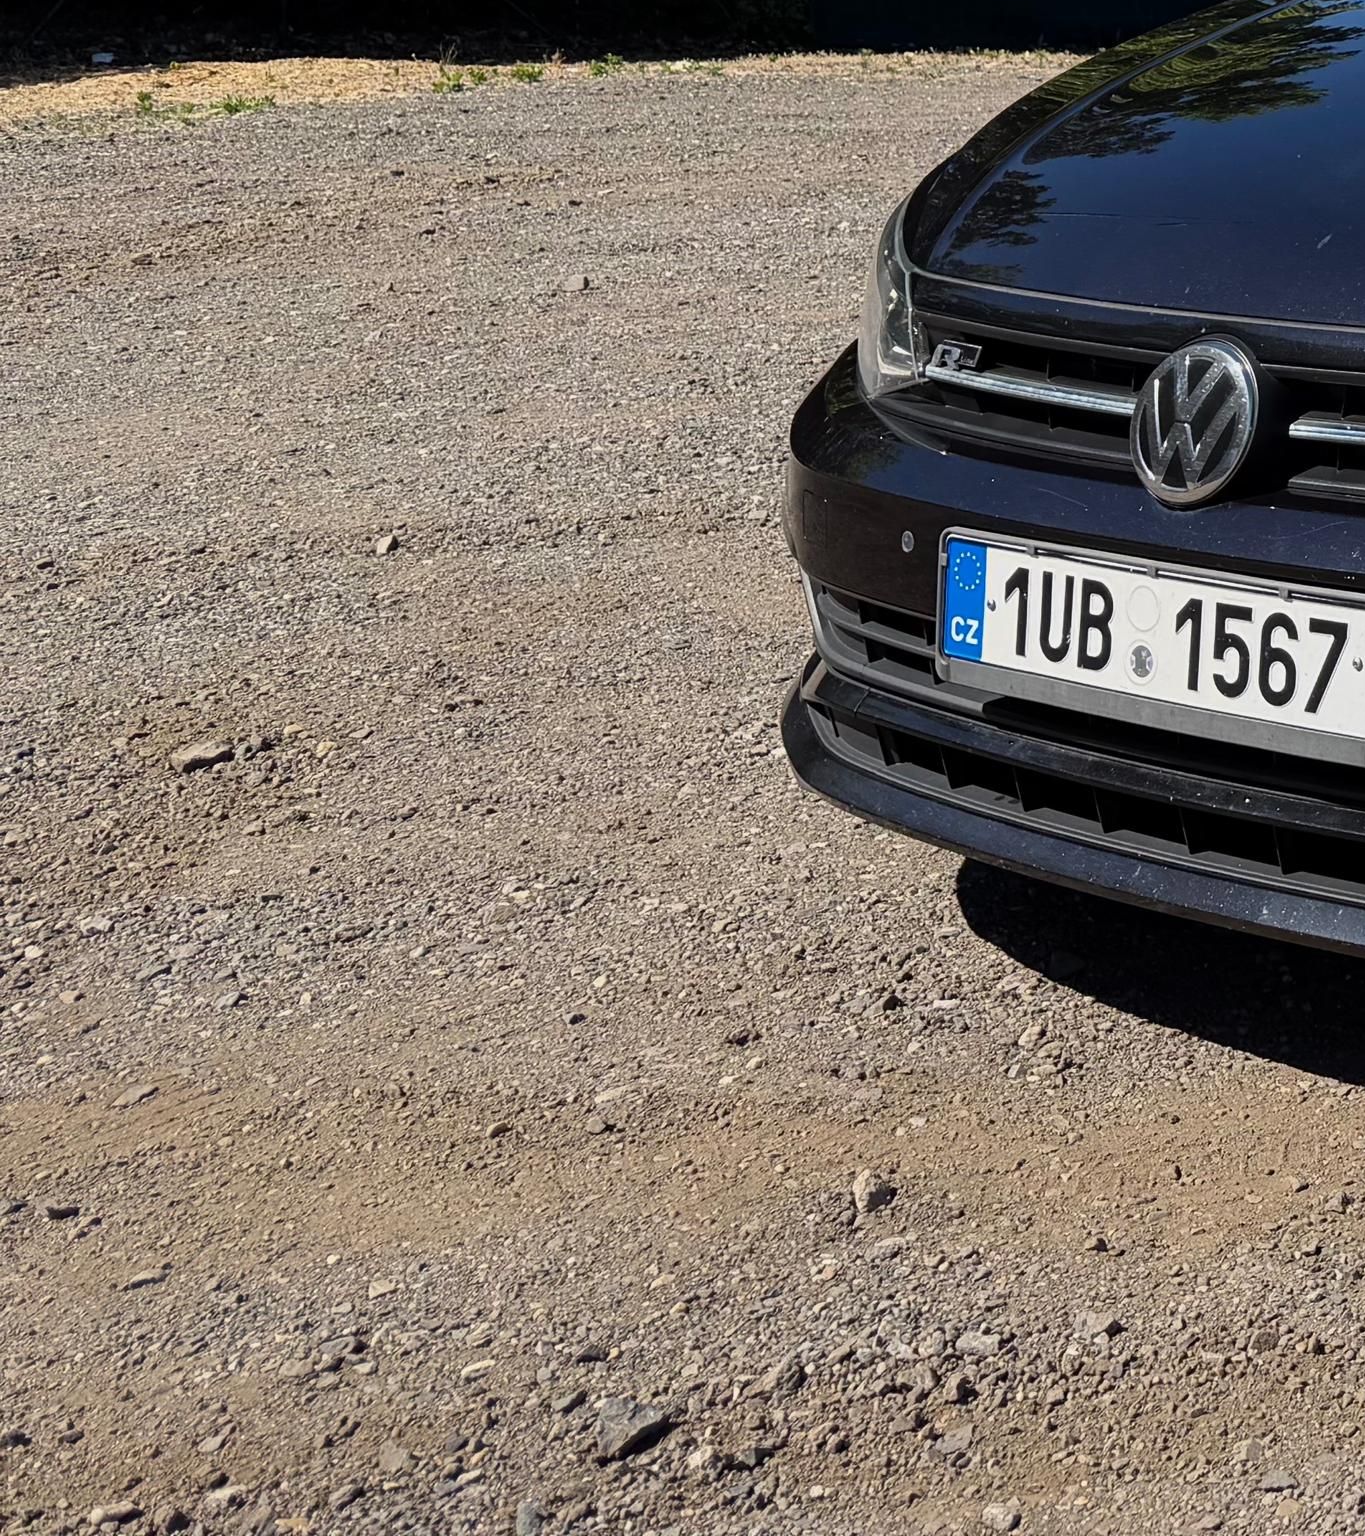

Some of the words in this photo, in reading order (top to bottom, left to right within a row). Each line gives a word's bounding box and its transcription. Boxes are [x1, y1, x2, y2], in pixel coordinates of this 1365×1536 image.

[950, 616, 979, 645] CZ
[1004, 566, 1114, 671] 1UB
[1174, 598, 1349, 715] 1567
